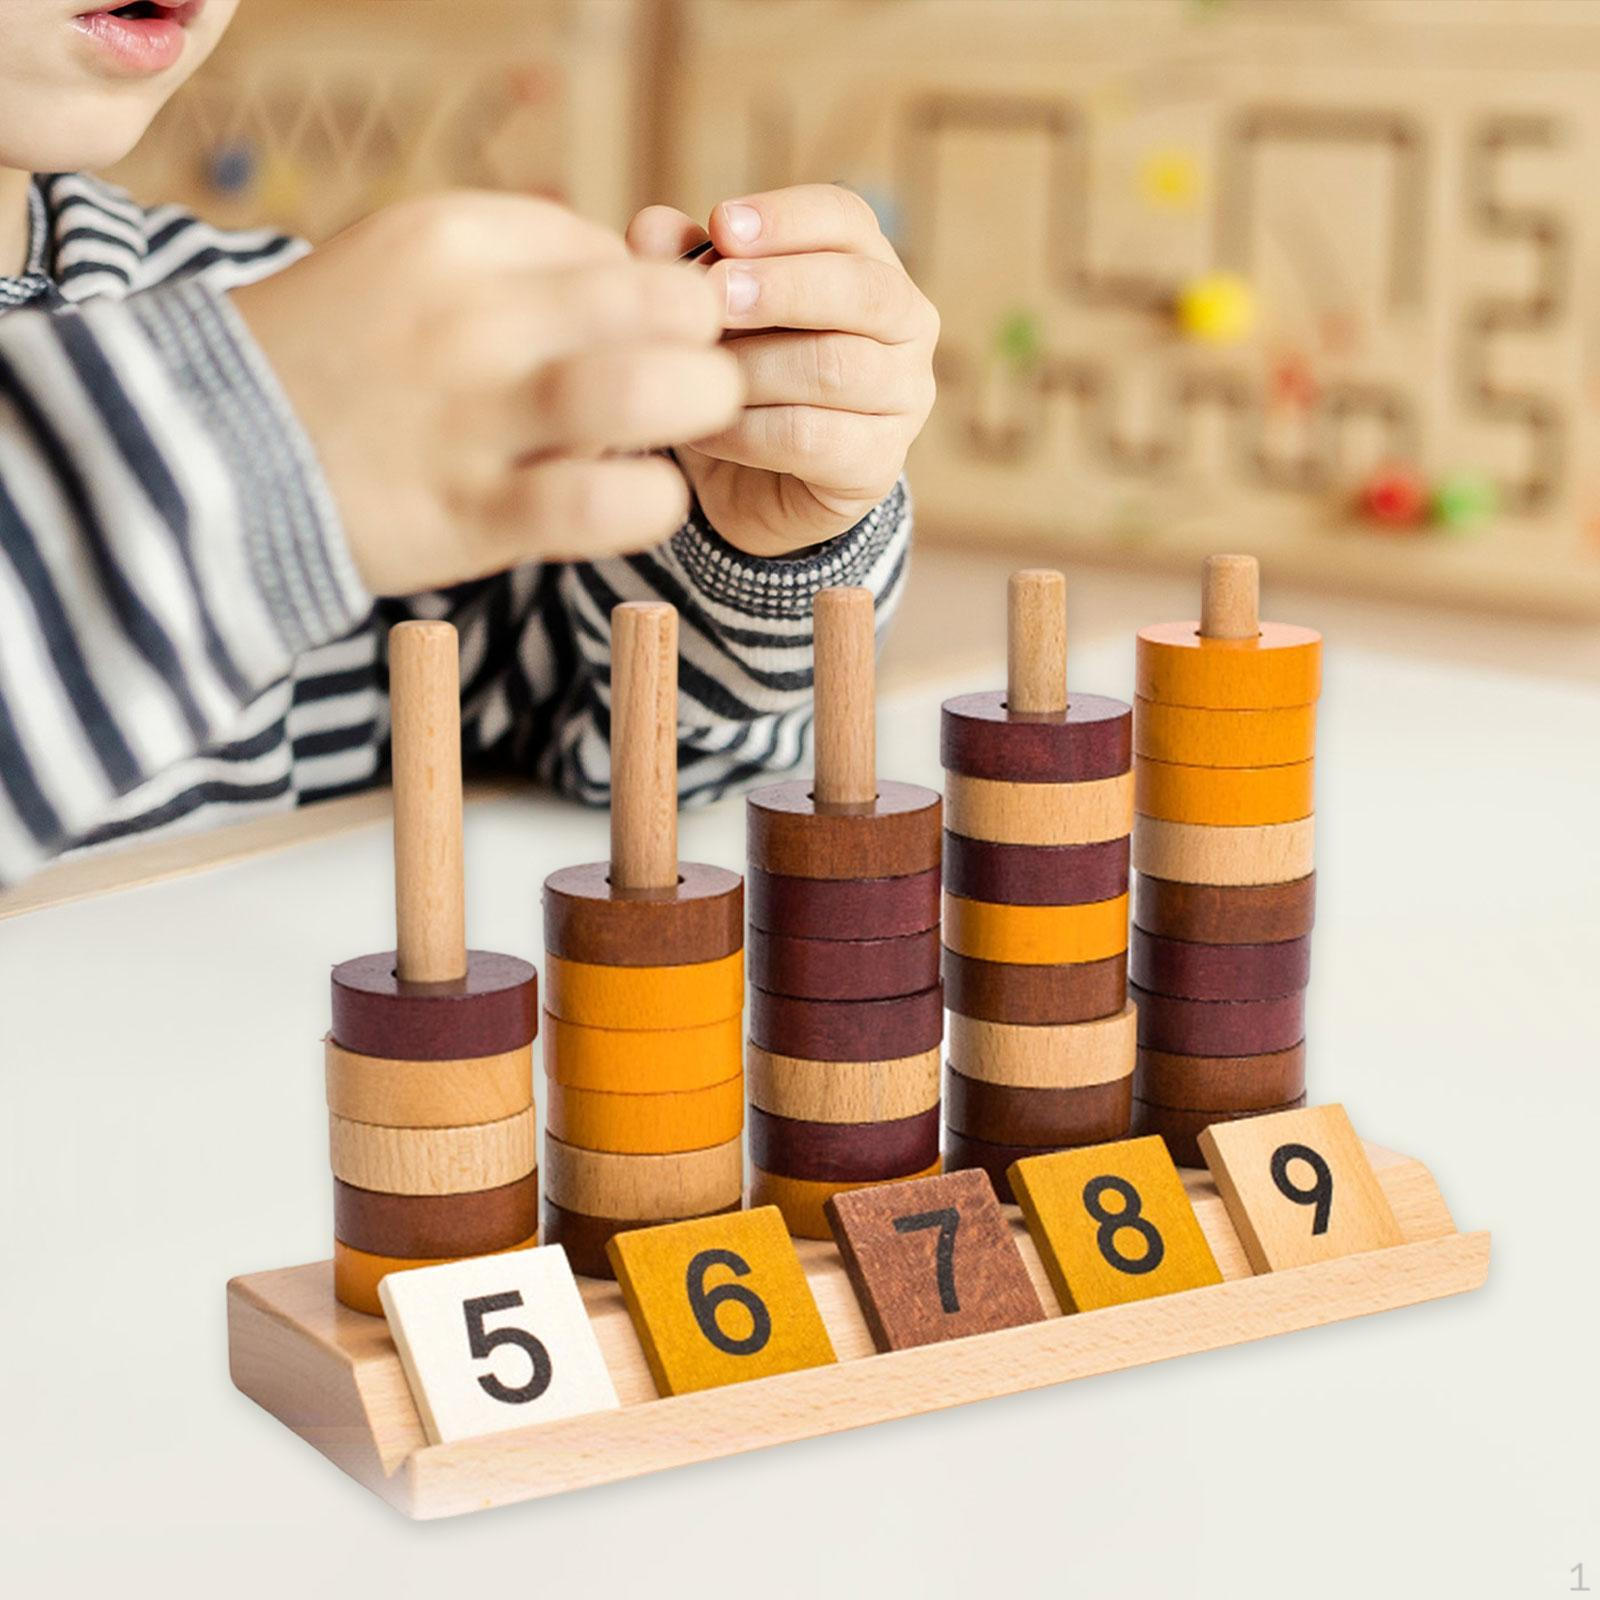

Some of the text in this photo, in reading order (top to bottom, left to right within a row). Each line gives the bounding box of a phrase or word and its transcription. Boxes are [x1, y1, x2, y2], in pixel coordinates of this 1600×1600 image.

[1082, 1175, 1164, 1275] 8
[1270, 1143, 1333, 1236] 9
[687, 1249, 772, 1357] 6
[893, 1208, 961, 1313] 7
[462, 1290, 552, 1404] 5
